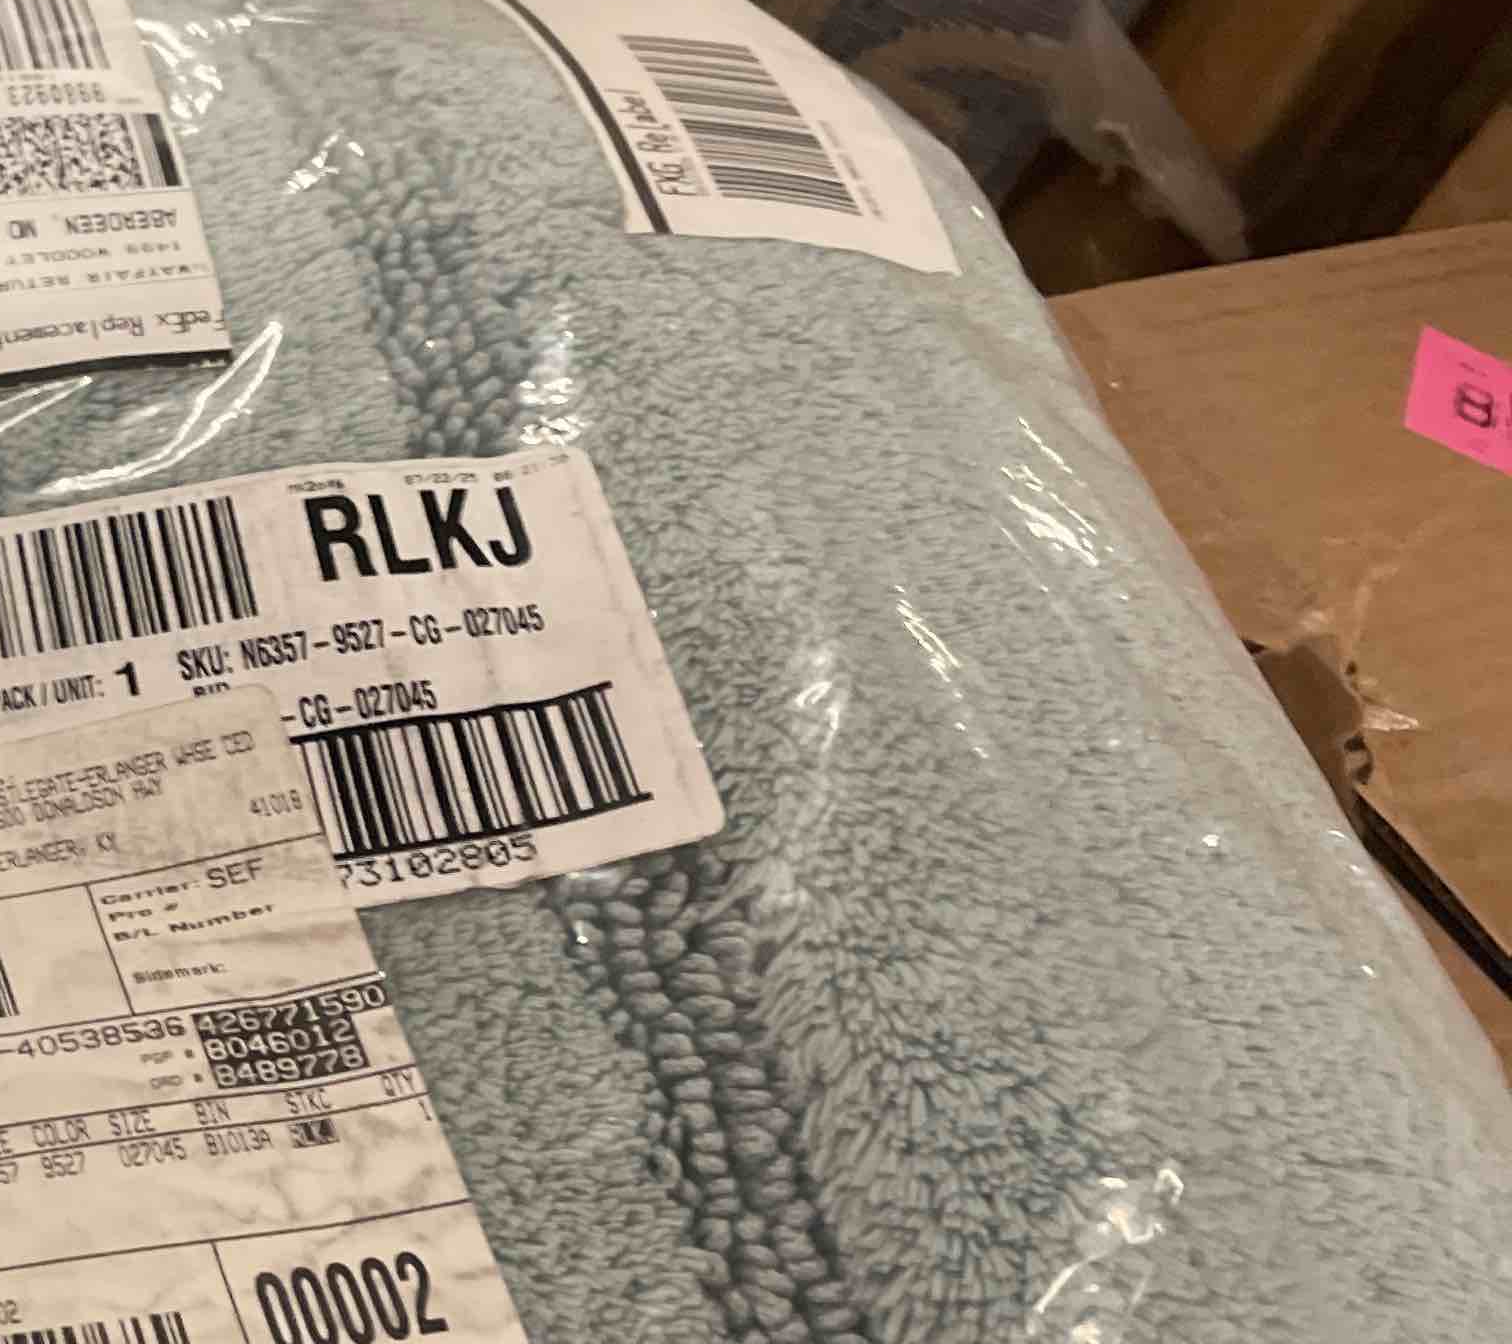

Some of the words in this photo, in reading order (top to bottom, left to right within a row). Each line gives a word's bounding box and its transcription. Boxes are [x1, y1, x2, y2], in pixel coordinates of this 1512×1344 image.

[154, 308, 226, 337] FedEx
[304, 486, 533, 582] RLKJ
[114, 660, 143, 697] 1
[176, 647, 234, 682] SKU:
[205, 857, 264, 889] SEF
[168, 905, 276, 933] Number
[196, 985, 386, 1036] 426771590
[204, 1019, 357, 1062] 8046012
[214, 1044, 365, 1088] 8489778
[108, 1109, 157, 1137] SIZE
[194, 1100, 232, 1125] BIN
[380, 1070, 420, 1098] QTY
